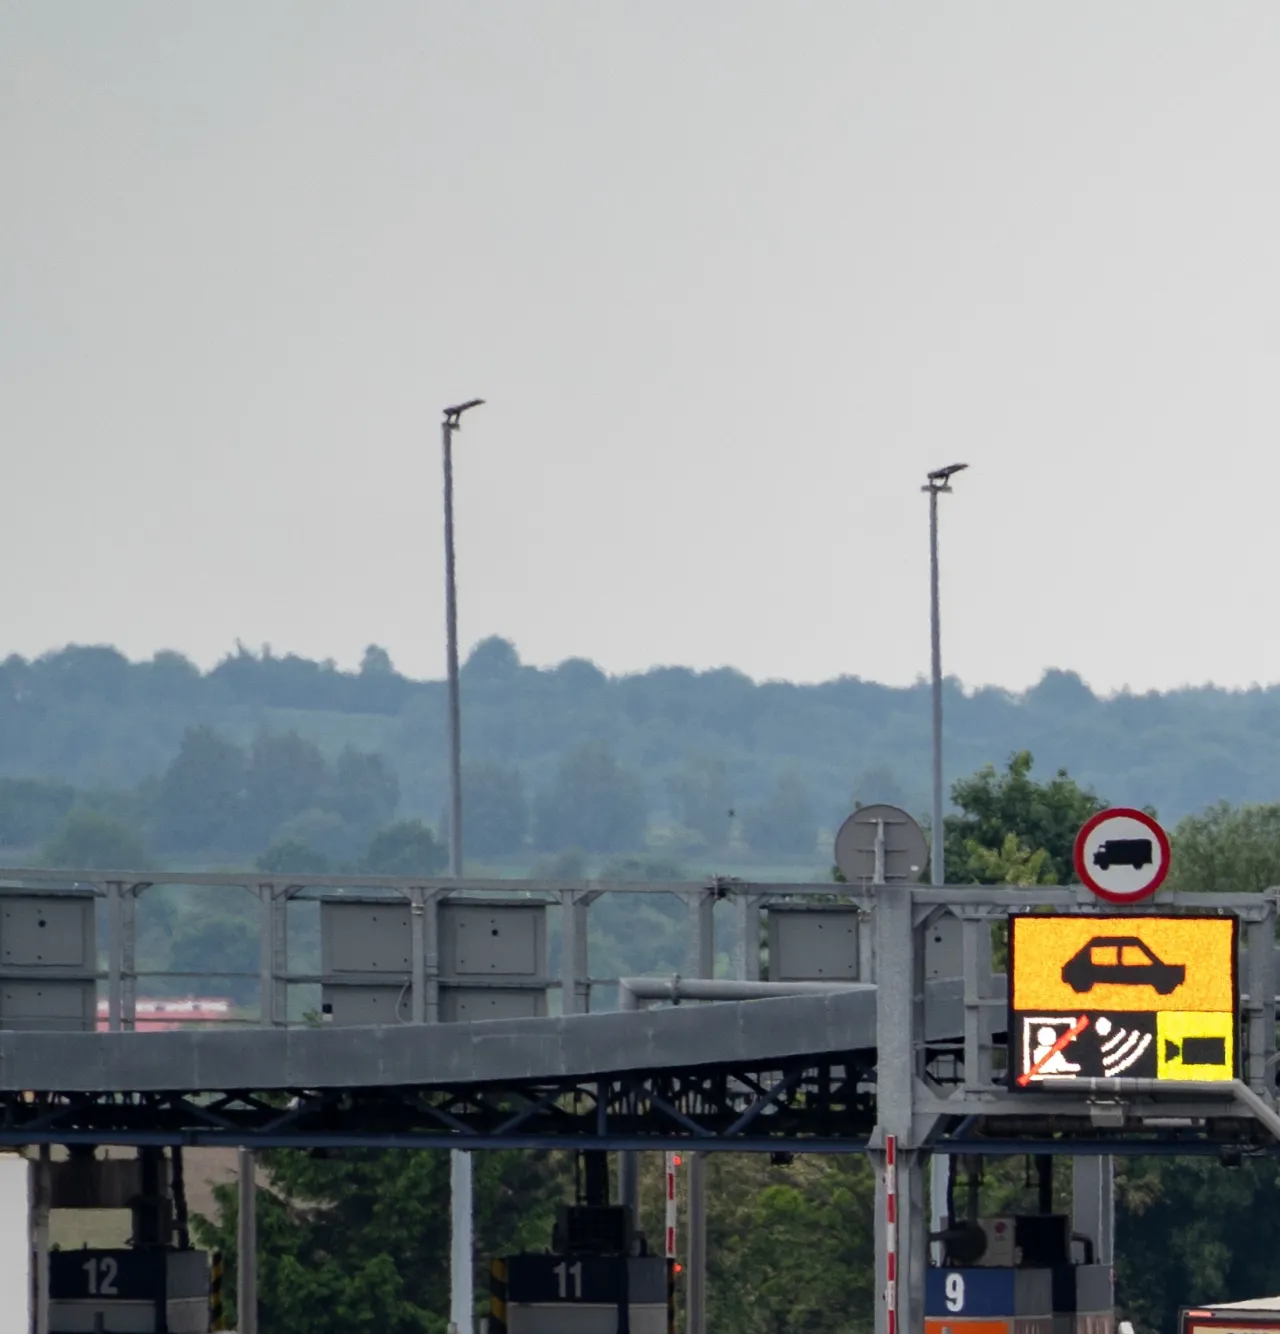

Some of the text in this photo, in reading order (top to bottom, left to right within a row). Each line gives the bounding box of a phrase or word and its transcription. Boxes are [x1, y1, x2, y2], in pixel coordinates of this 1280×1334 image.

[82, 1257, 118, 1295] 12
[552, 1261, 582, 1298] 11
[945, 1272, 964, 1312] 9
